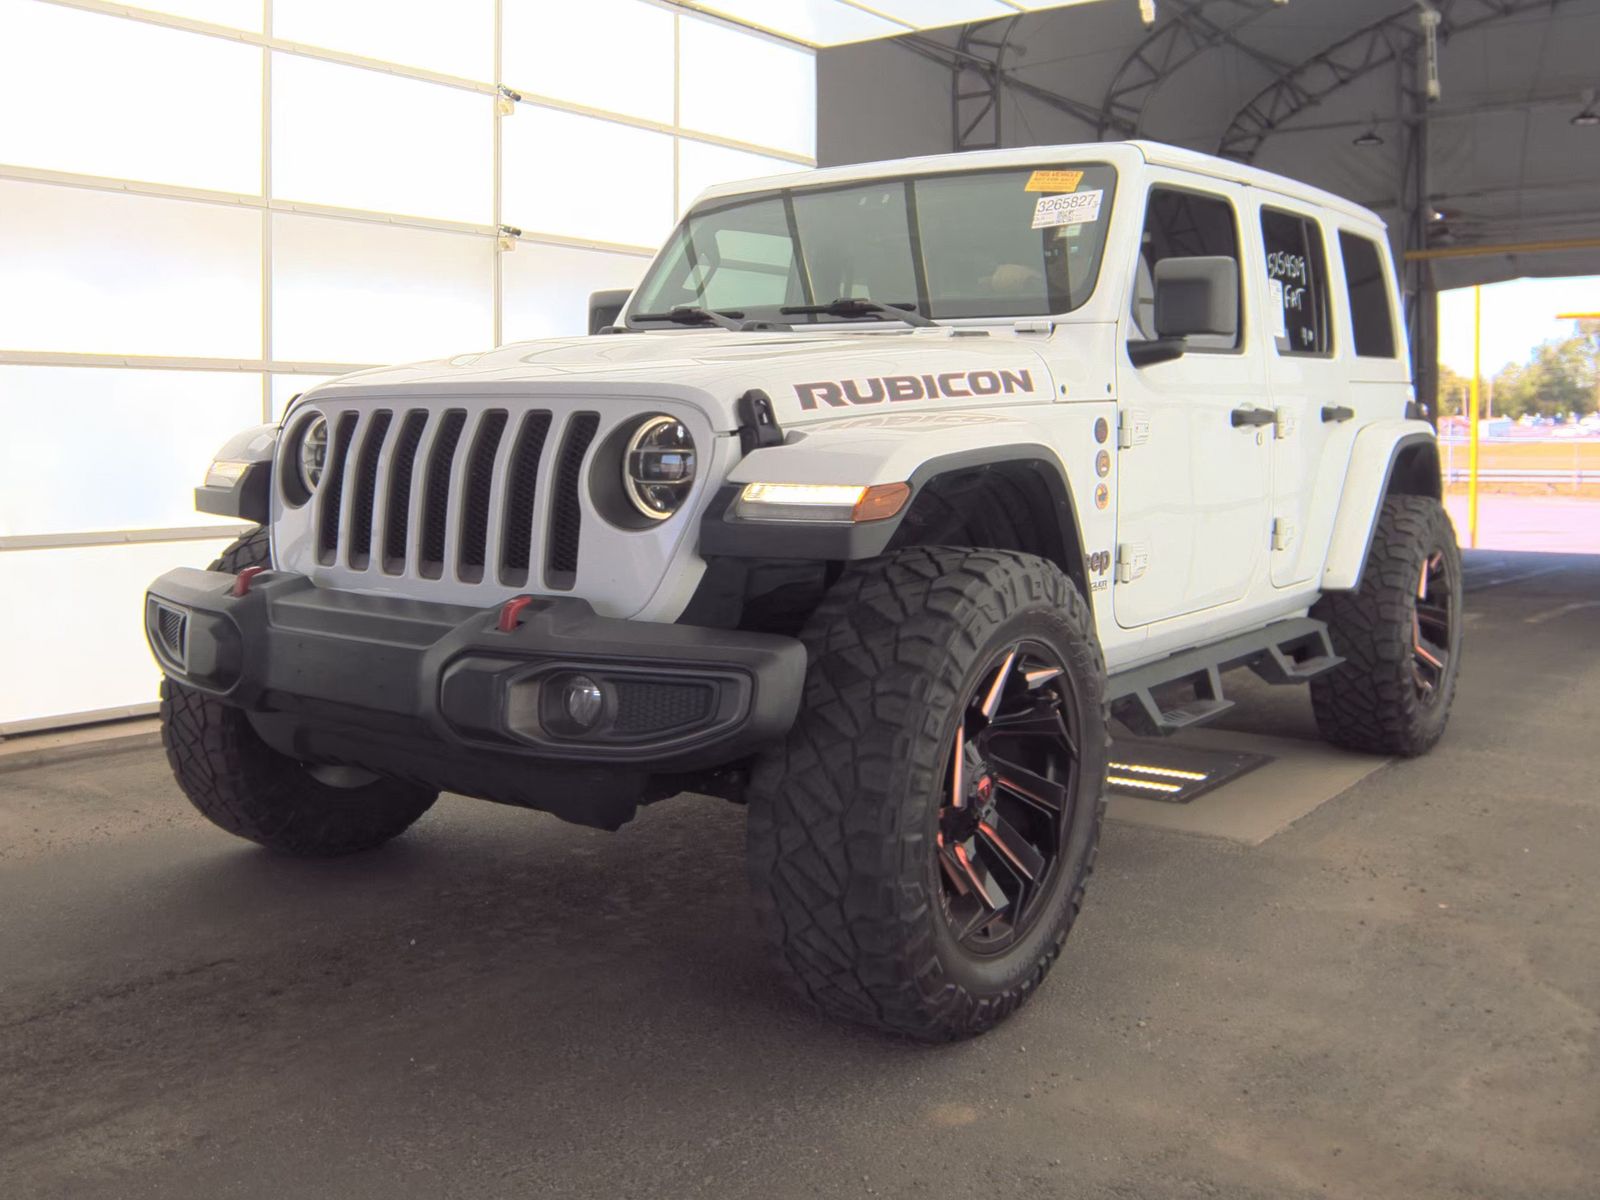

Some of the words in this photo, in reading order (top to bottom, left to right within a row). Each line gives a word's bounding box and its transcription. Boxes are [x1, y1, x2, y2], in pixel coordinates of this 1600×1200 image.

[1037, 194, 1096, 213] 3265827
[793, 368, 1035, 411] RUBICON
[1085, 550, 1111, 576] eep
